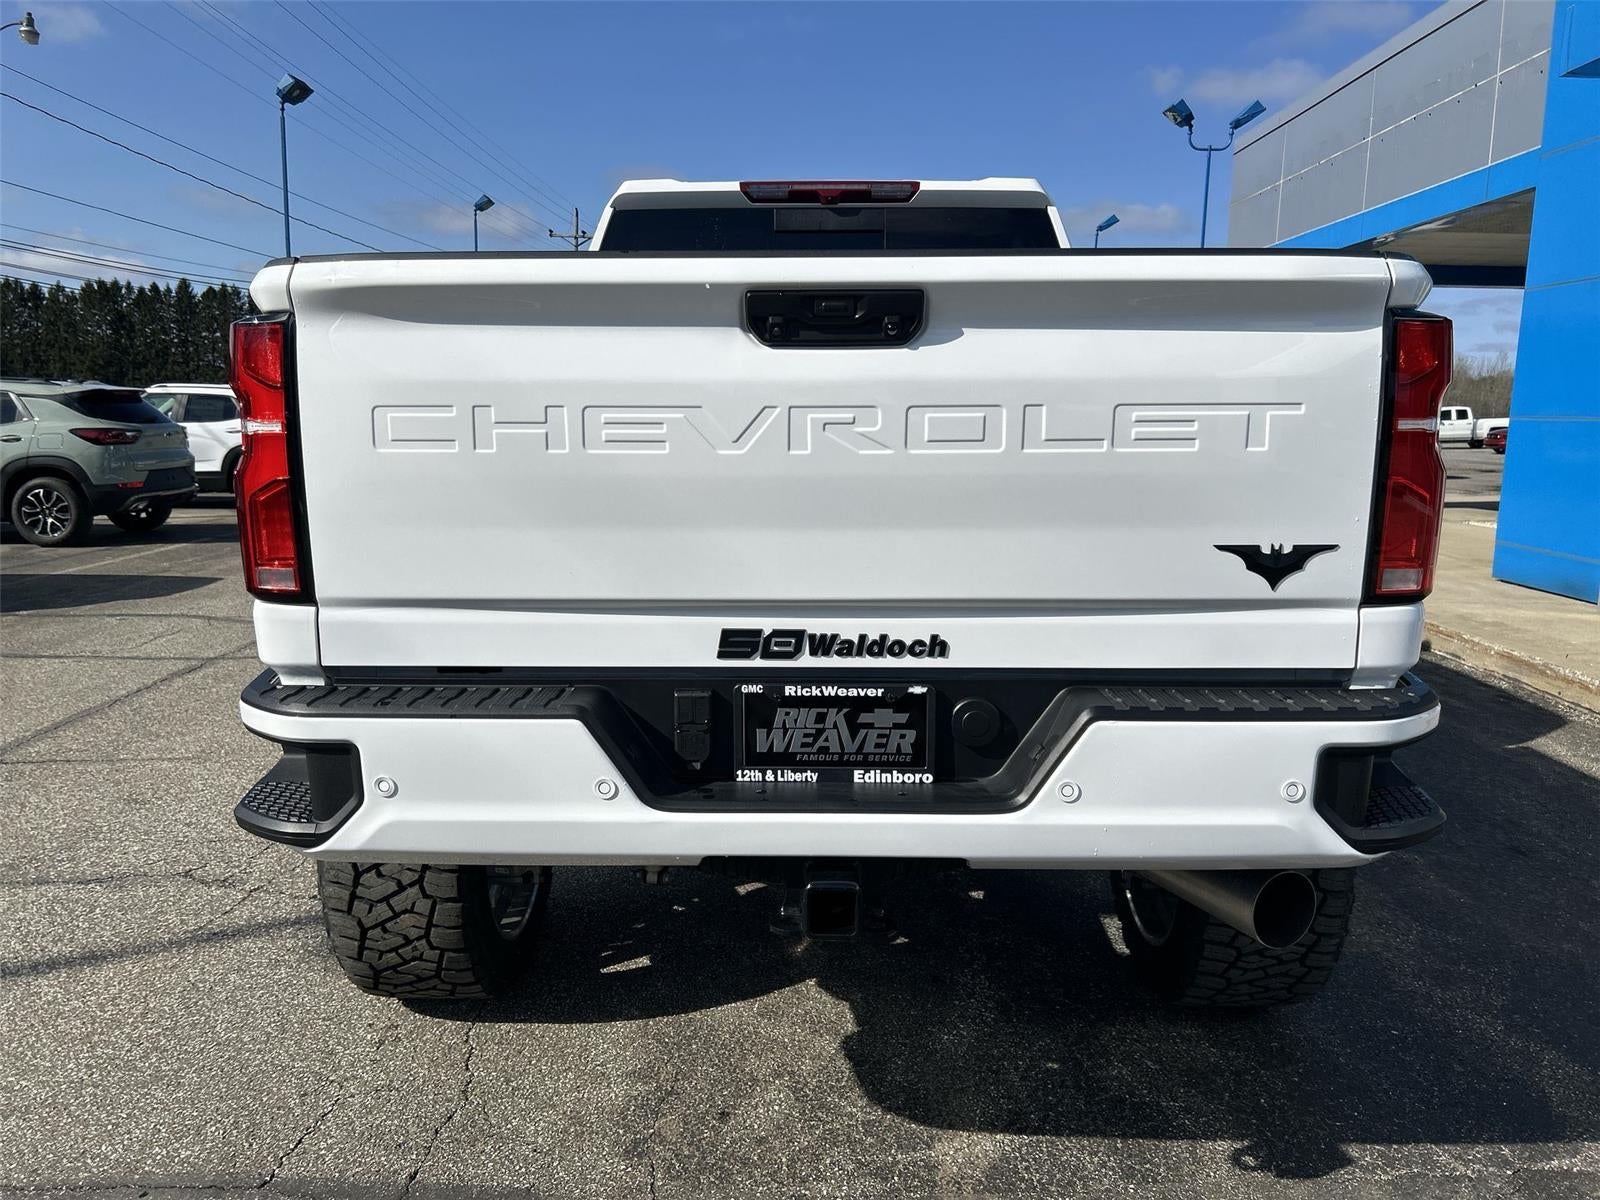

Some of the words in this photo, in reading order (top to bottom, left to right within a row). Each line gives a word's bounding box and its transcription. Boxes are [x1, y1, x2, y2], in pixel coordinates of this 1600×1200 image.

[372, 403, 1305, 454] CHEVROLET
[808, 633, 951, 659] Waldoch
[741, 684, 764, 694] GMC
[784, 685, 885, 697] RickWeaver
[773, 707, 851, 729] RICK
[756, 728, 917, 754] WEAVER
[796, 754, 839, 762] FAMOUS
[843, 754, 864, 762] FOR
[867, 754, 912, 762] SERVICE
[736, 769, 763, 783] 12th
[765, 770, 775, 783] &
[777, 769, 818, 784] Liberty
[853, 769, 934, 784] Edinboro
